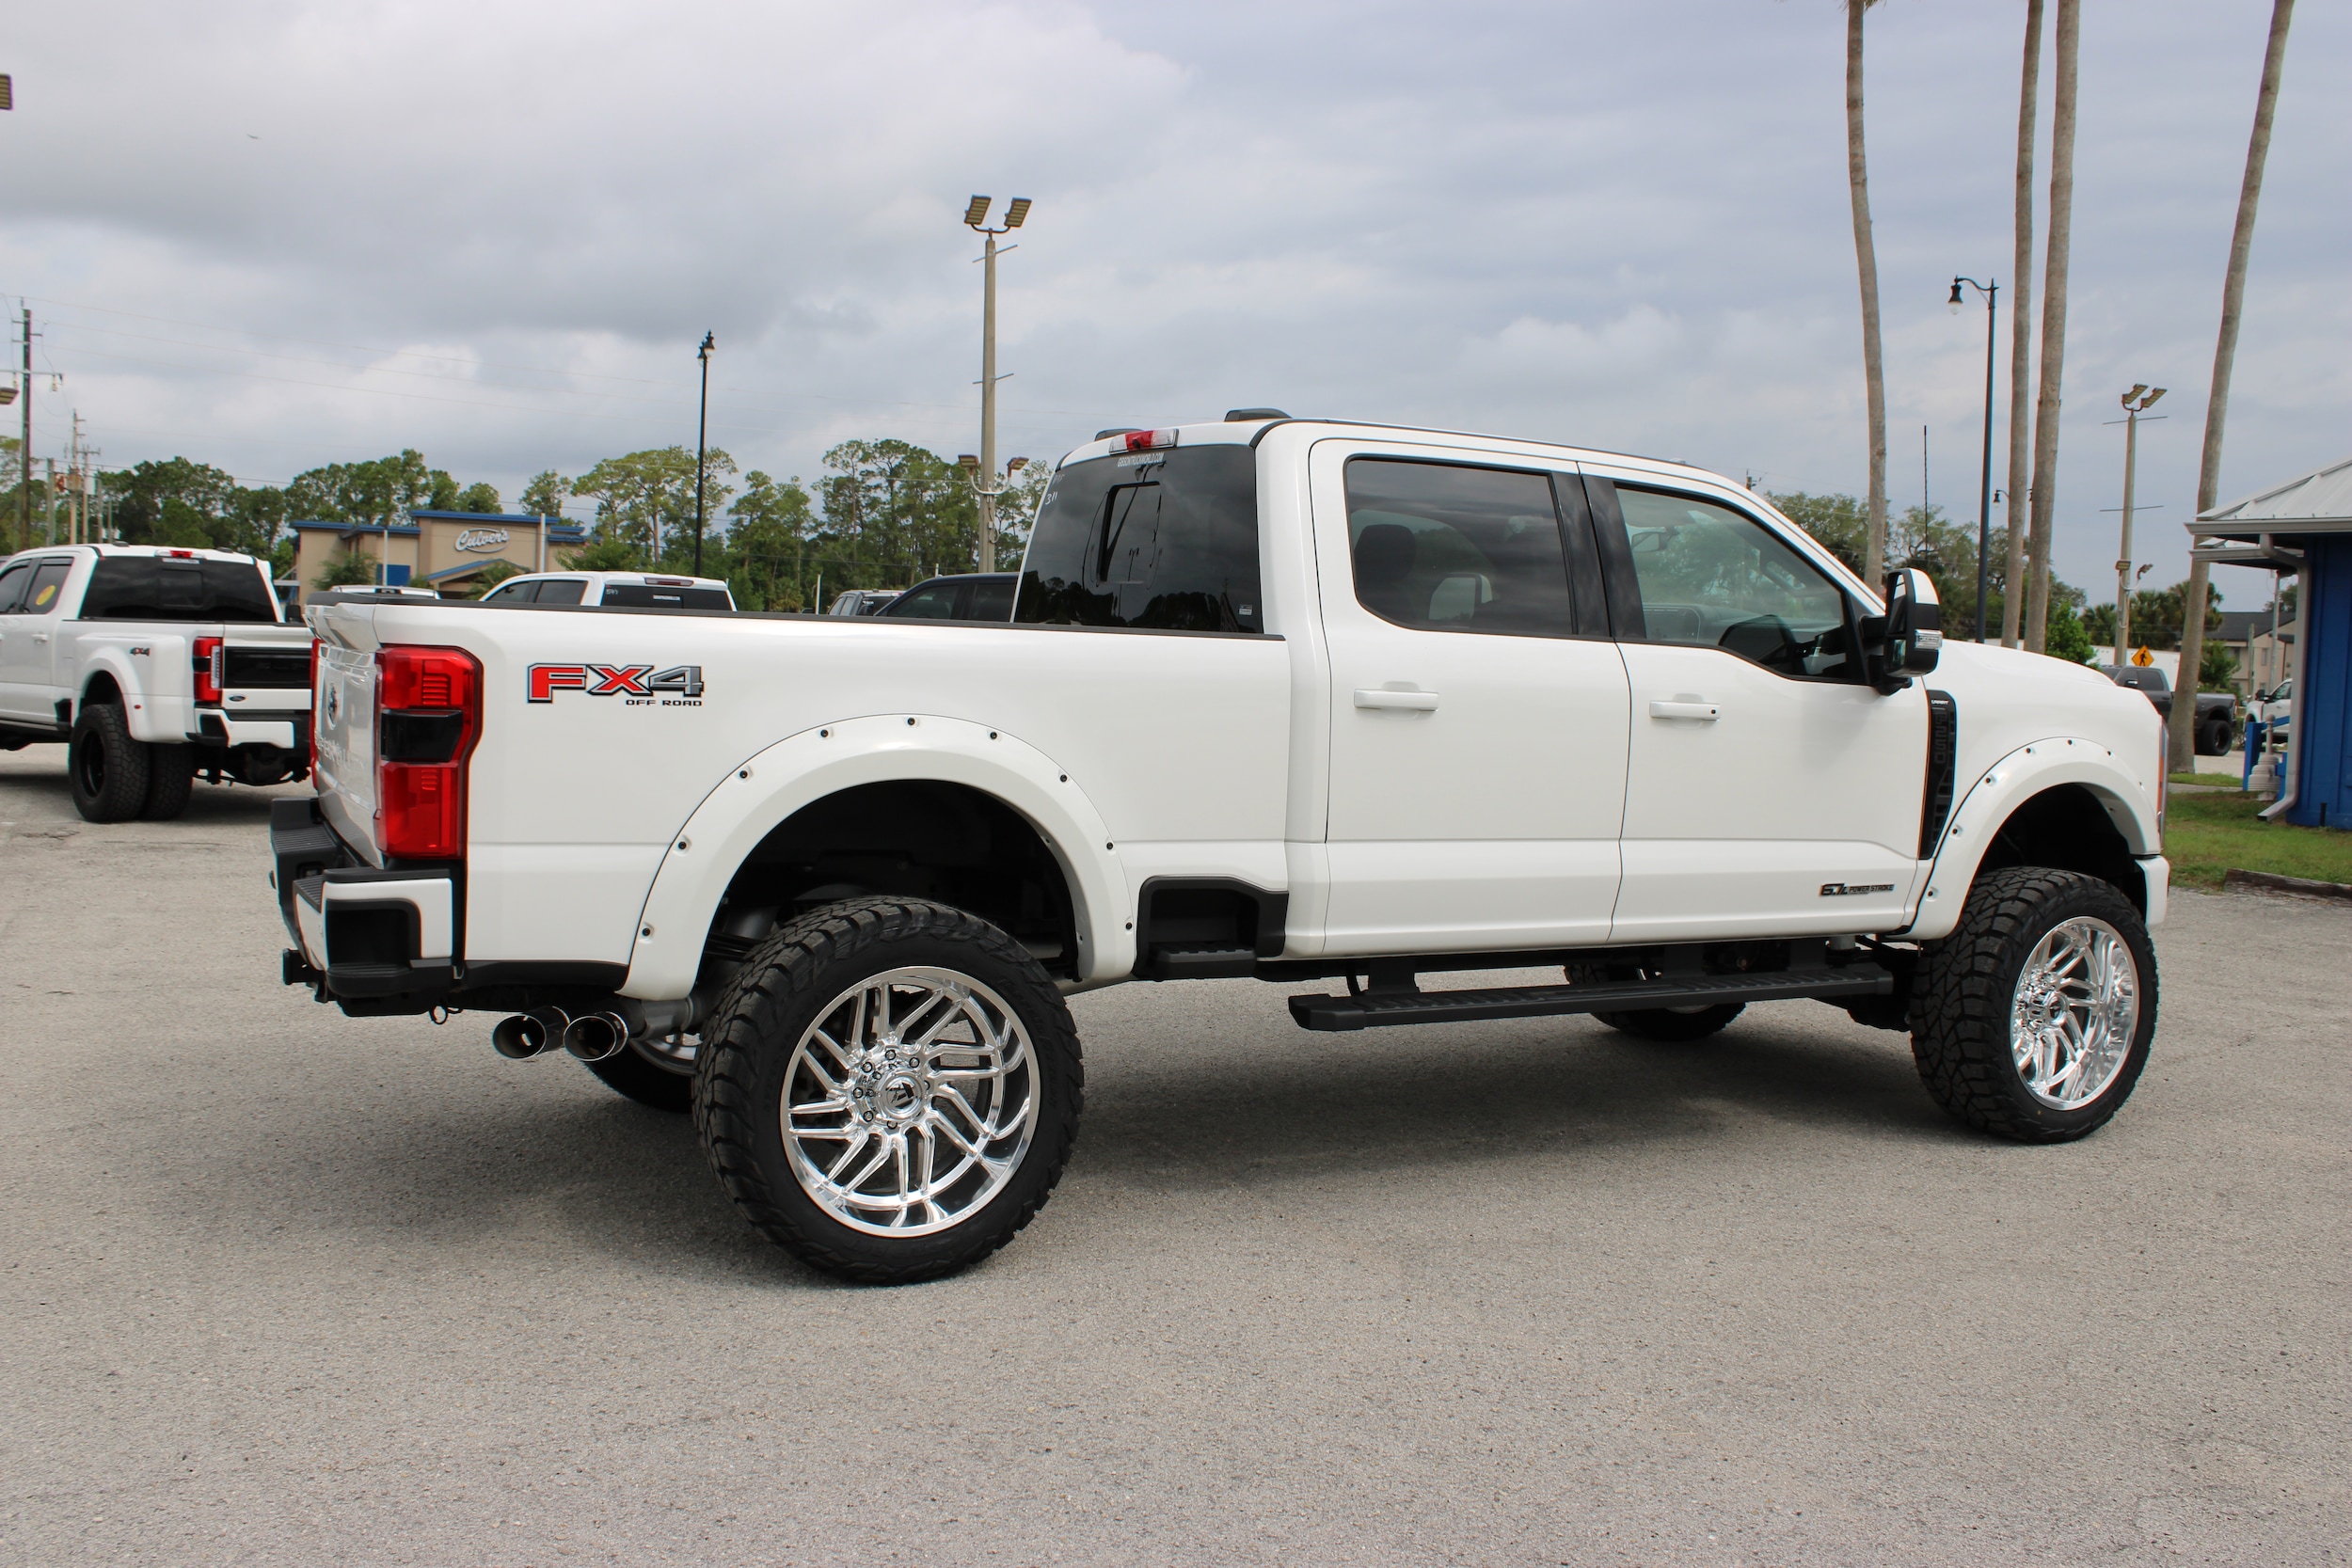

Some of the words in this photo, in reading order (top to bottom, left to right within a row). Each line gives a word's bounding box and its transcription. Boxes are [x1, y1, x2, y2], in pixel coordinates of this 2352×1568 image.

[455, 528, 509, 551] Culver's
[527, 662, 704, 704] FX4
[661, 699, 703, 707] ROAD
